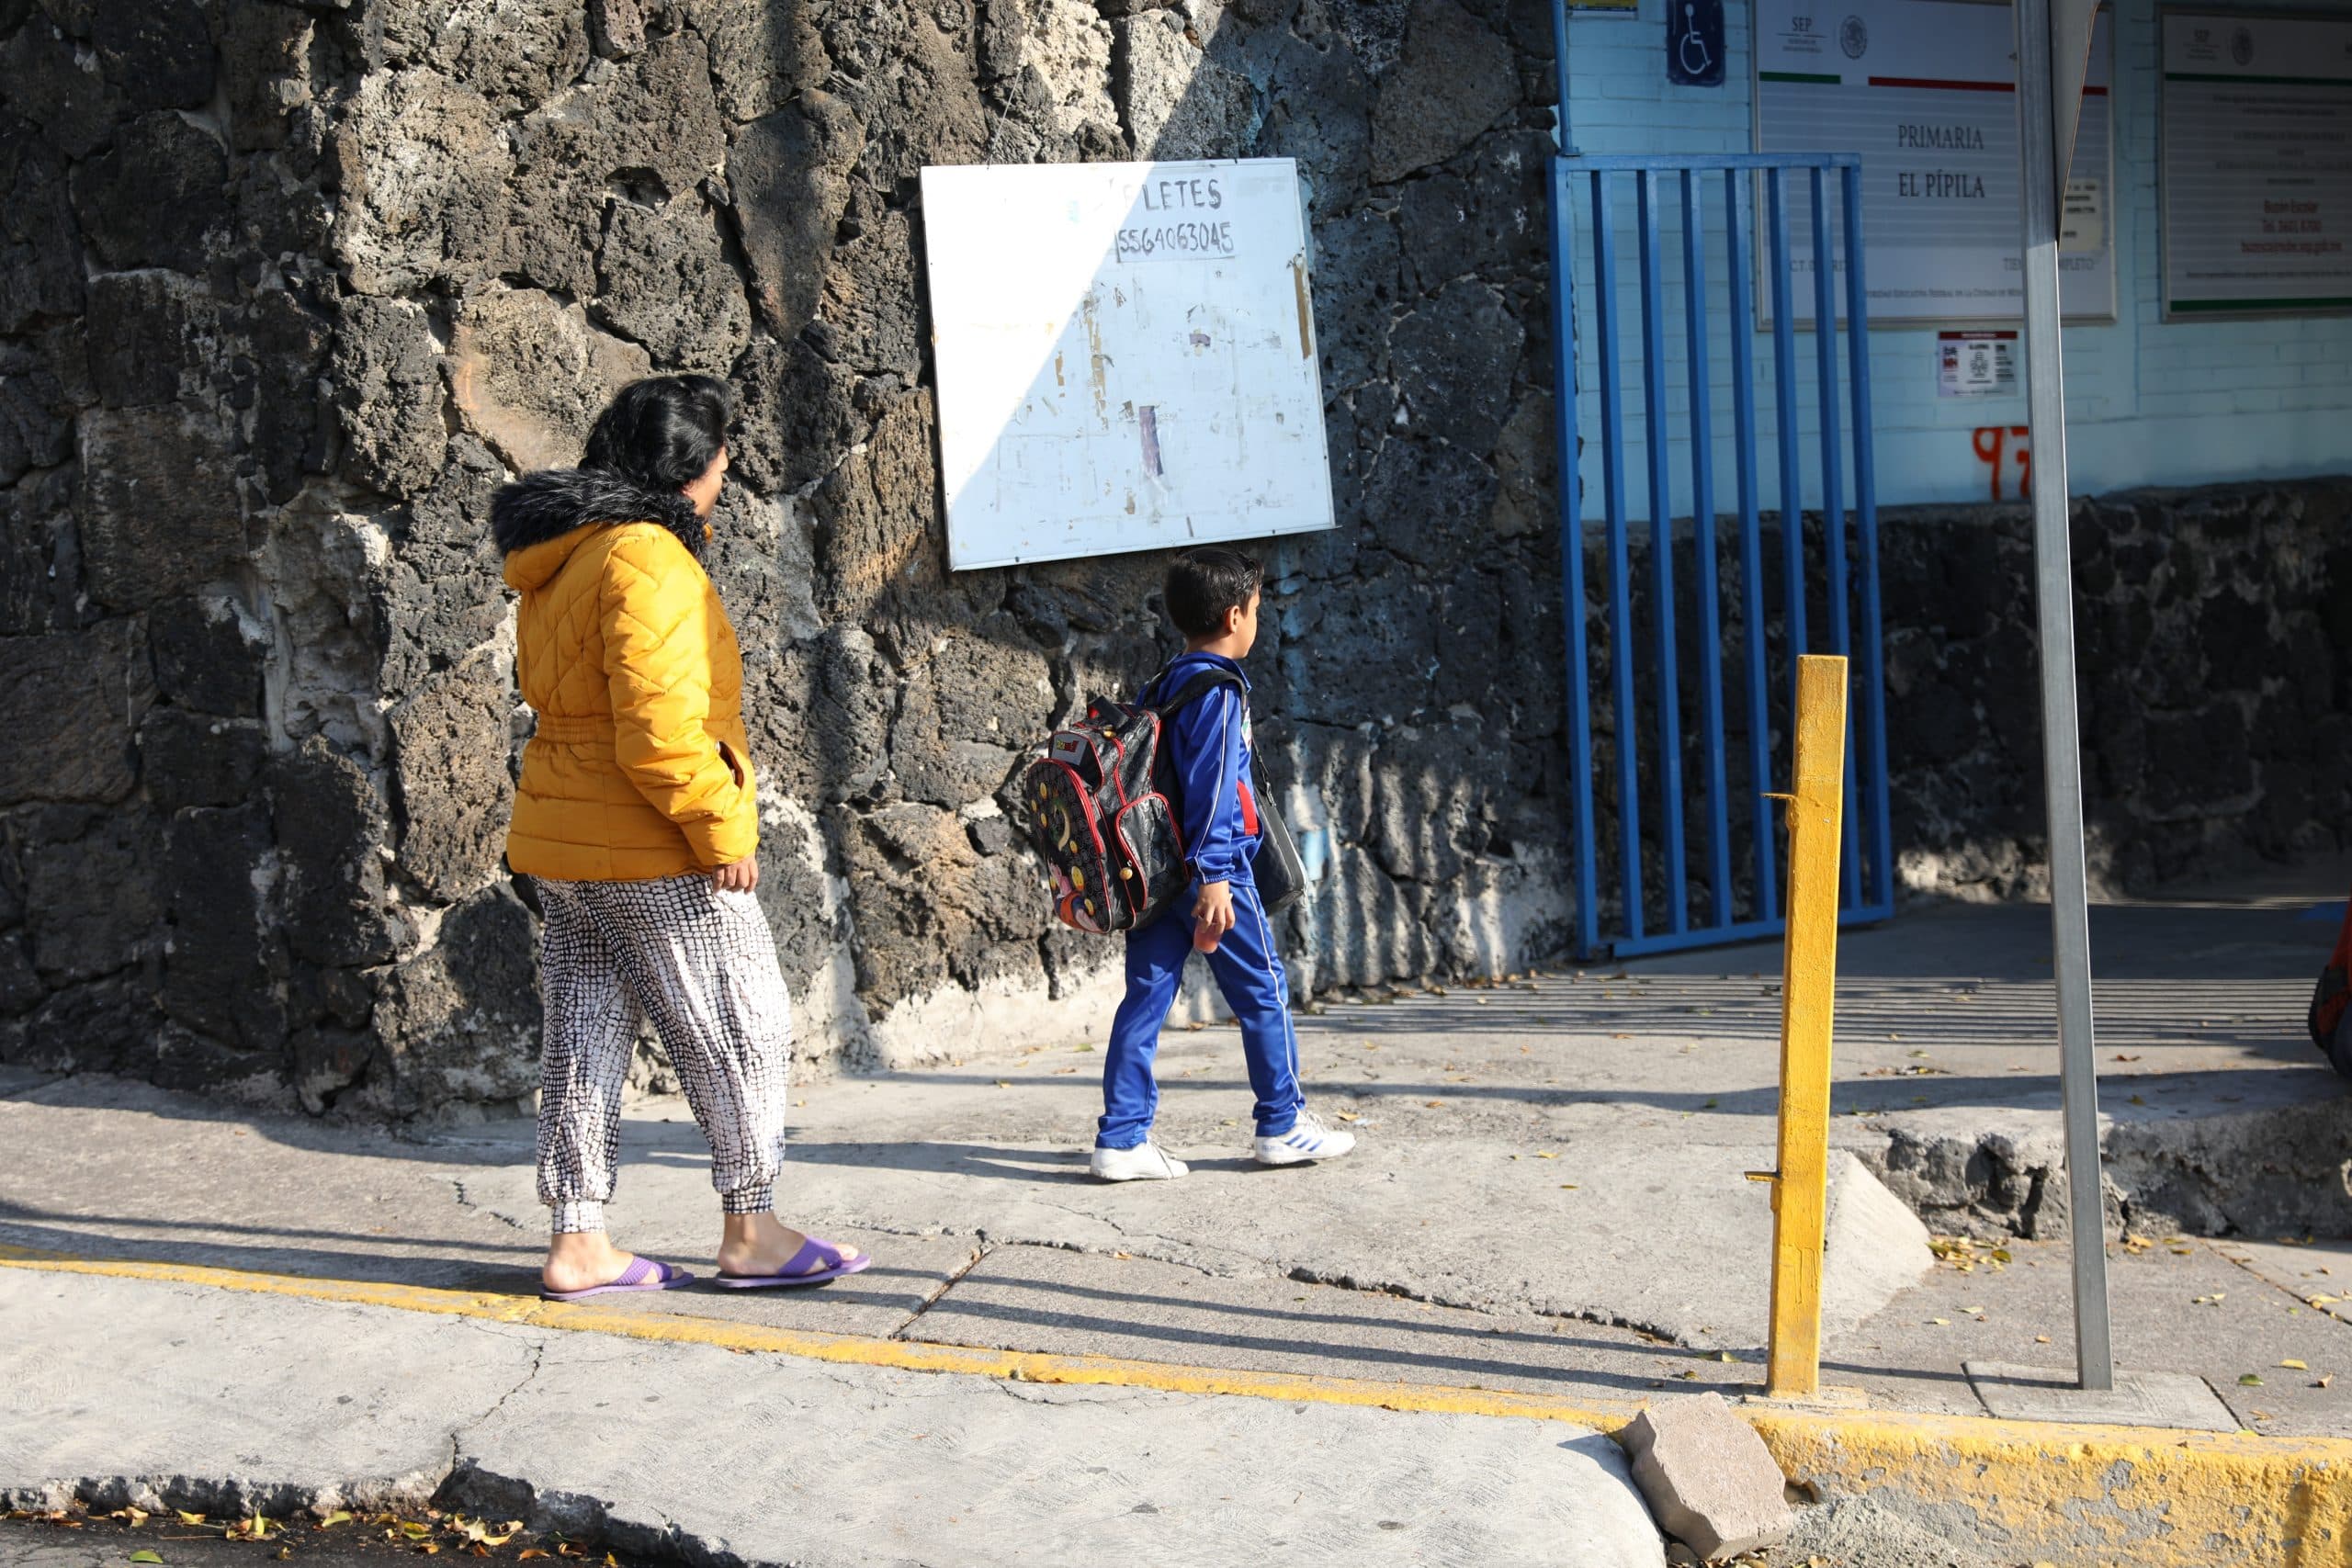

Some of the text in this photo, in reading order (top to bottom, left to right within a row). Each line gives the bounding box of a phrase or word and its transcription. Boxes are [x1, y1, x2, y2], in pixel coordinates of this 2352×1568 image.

[1792, 17, 1813, 31] SEP
[1898, 124, 1984, 151] PRIMARIA
[1898, 168, 1985, 198] EL PÍPILA
